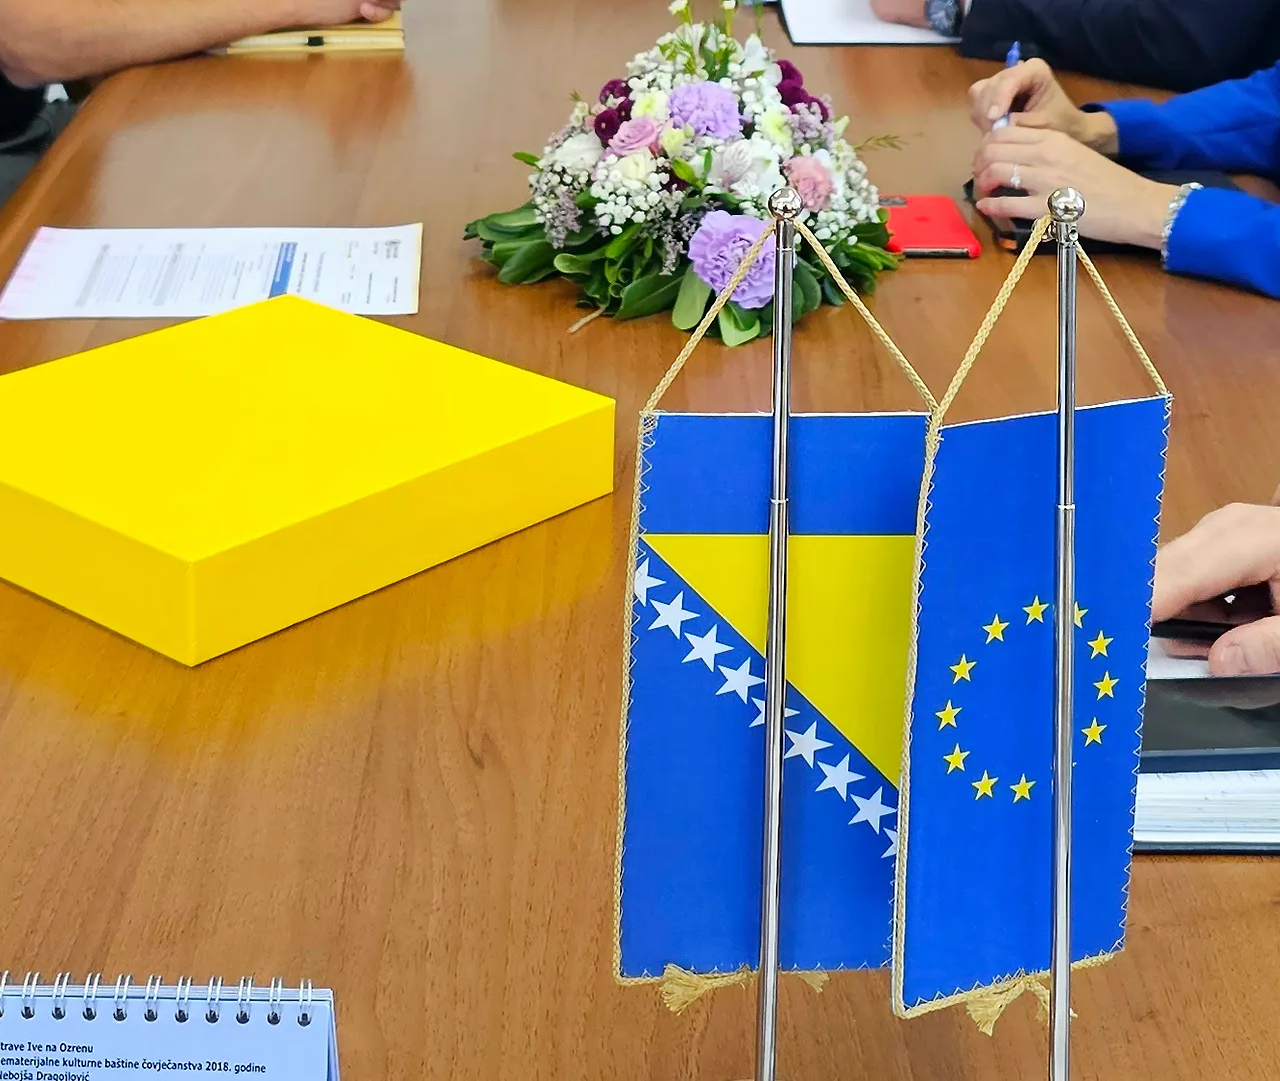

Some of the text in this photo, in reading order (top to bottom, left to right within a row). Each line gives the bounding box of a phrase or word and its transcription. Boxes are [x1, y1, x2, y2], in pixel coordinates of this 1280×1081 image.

[0, 1041, 25, 1052] trave
[27, 1041, 43, 1052] Ive
[45, 1044, 57, 1052] na
[59, 1042, 94, 1053] Ozrenu
[62, 1057, 102, 1068] kulturne
[104, 1058, 140, 1069] baštine
[141, 1058, 203, 1072] čovječanstva
[205, 1061, 232, 1072] 2018.
[234, 1062, 267, 1075] godine
